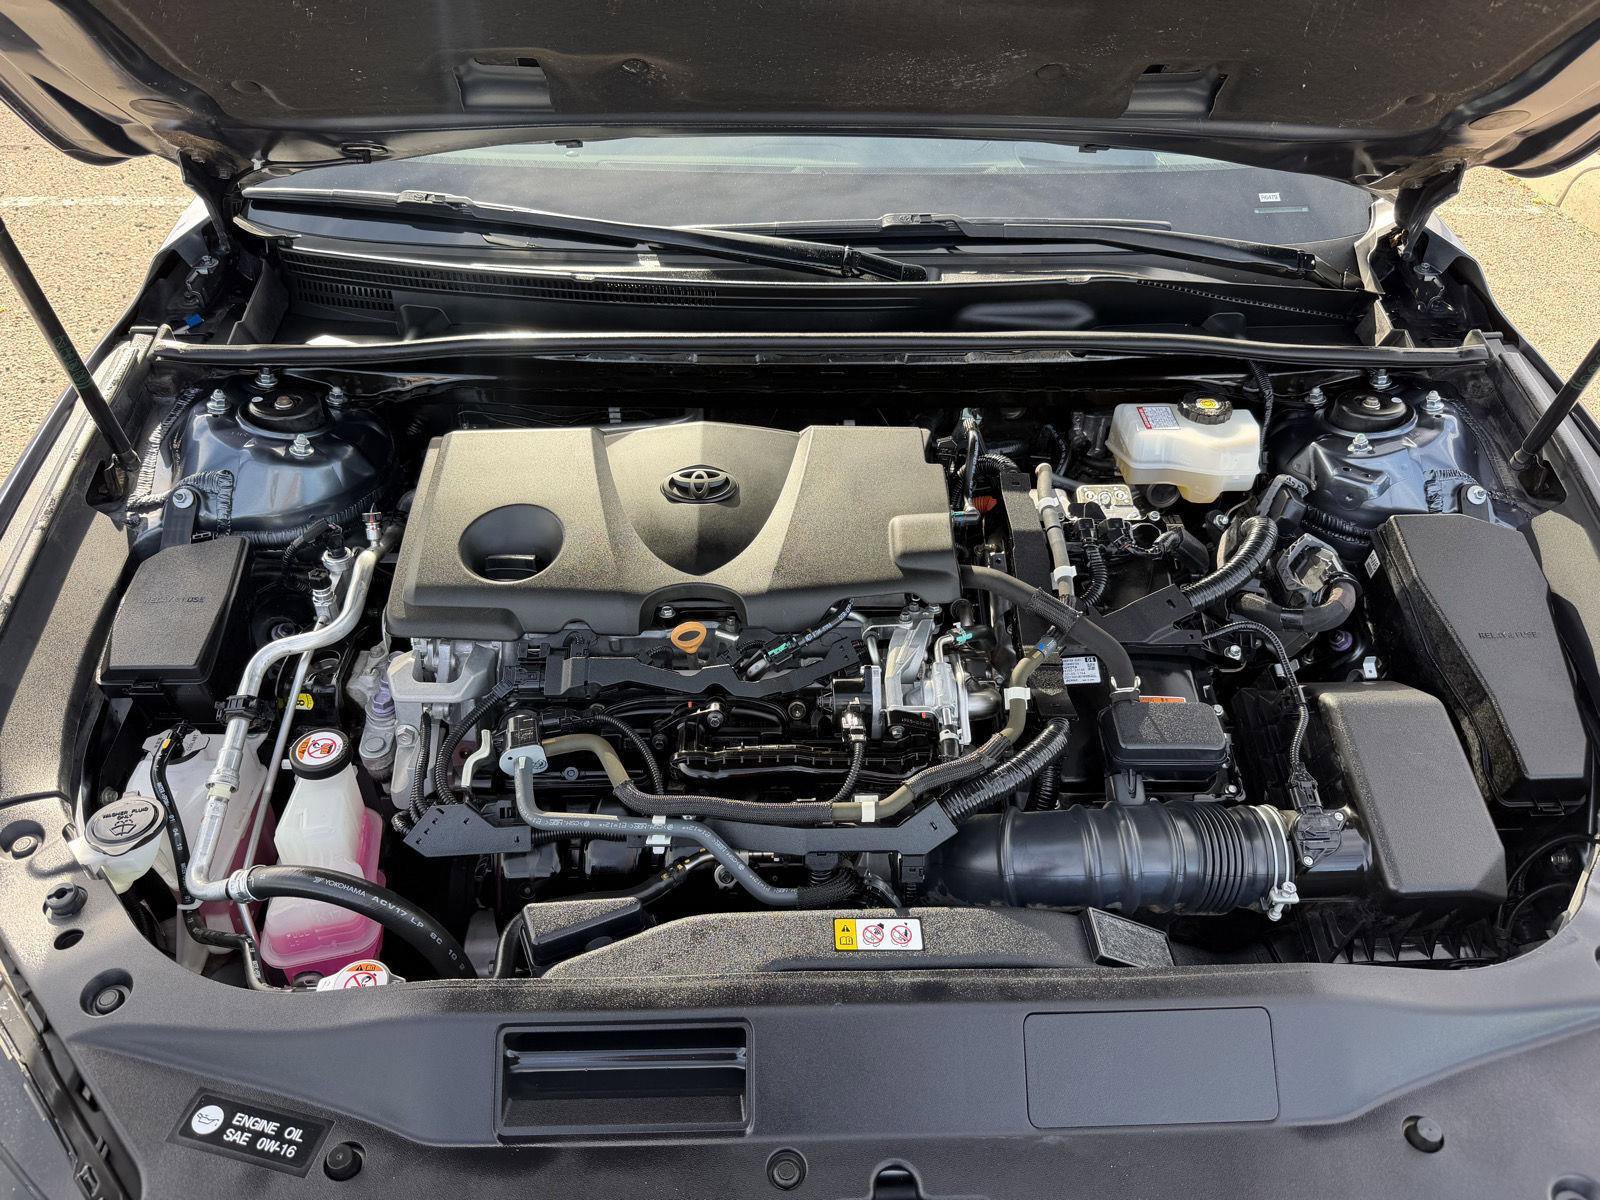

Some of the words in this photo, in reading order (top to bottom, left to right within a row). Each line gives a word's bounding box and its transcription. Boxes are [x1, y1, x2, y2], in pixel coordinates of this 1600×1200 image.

[325, 878, 367, 897] YOKOHAMA
[371, 895, 408, 917] ACV17
[410, 916, 425, 928] LP
[223, 1128, 252, 1146] SAE
[256, 1137, 297, 1158] 0W-16
[232, 1112, 280, 1135] ENGINE
[284, 1126, 304, 1143] OIL
